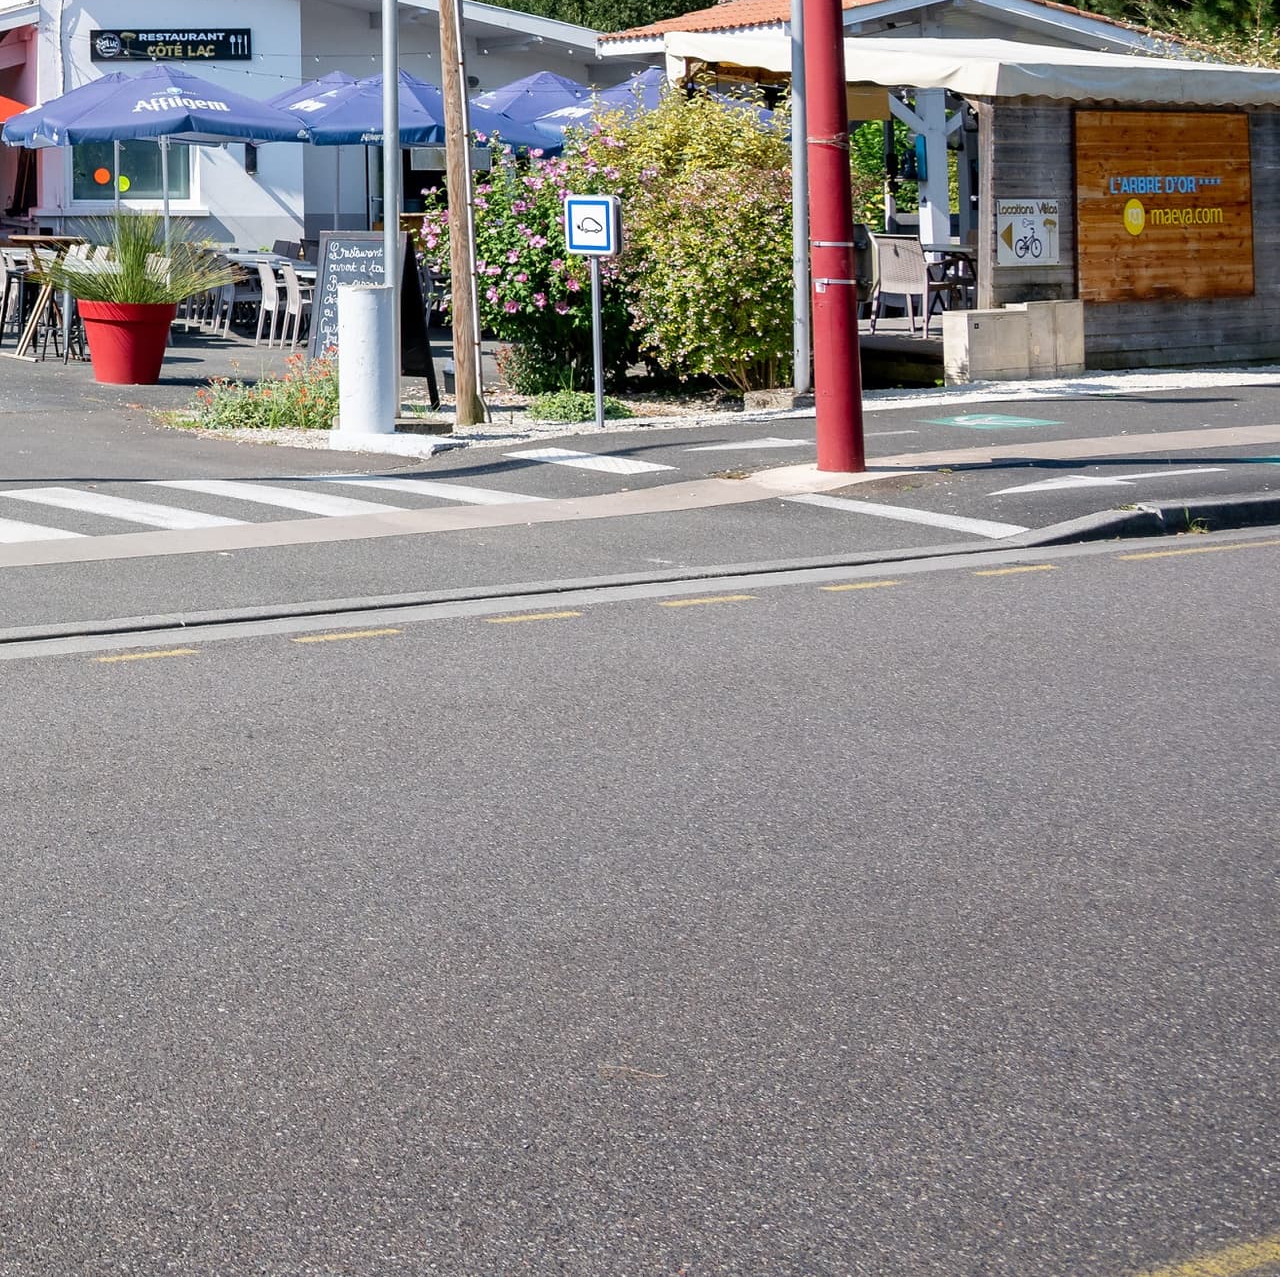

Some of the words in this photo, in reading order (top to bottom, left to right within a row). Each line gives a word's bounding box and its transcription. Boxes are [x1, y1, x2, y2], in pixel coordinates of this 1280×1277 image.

[138, 32, 226, 42] RESTAURANT
[146, 42, 183, 57] CÔTÉ
[187, 44, 216, 57] LAC
[132, 95, 231, 113] Affligem
[1108, 176, 1162, 194] L'ARBRE
[1165, 176, 1197, 194] D'OR
[1150, 207, 1224, 225] maeva.com
